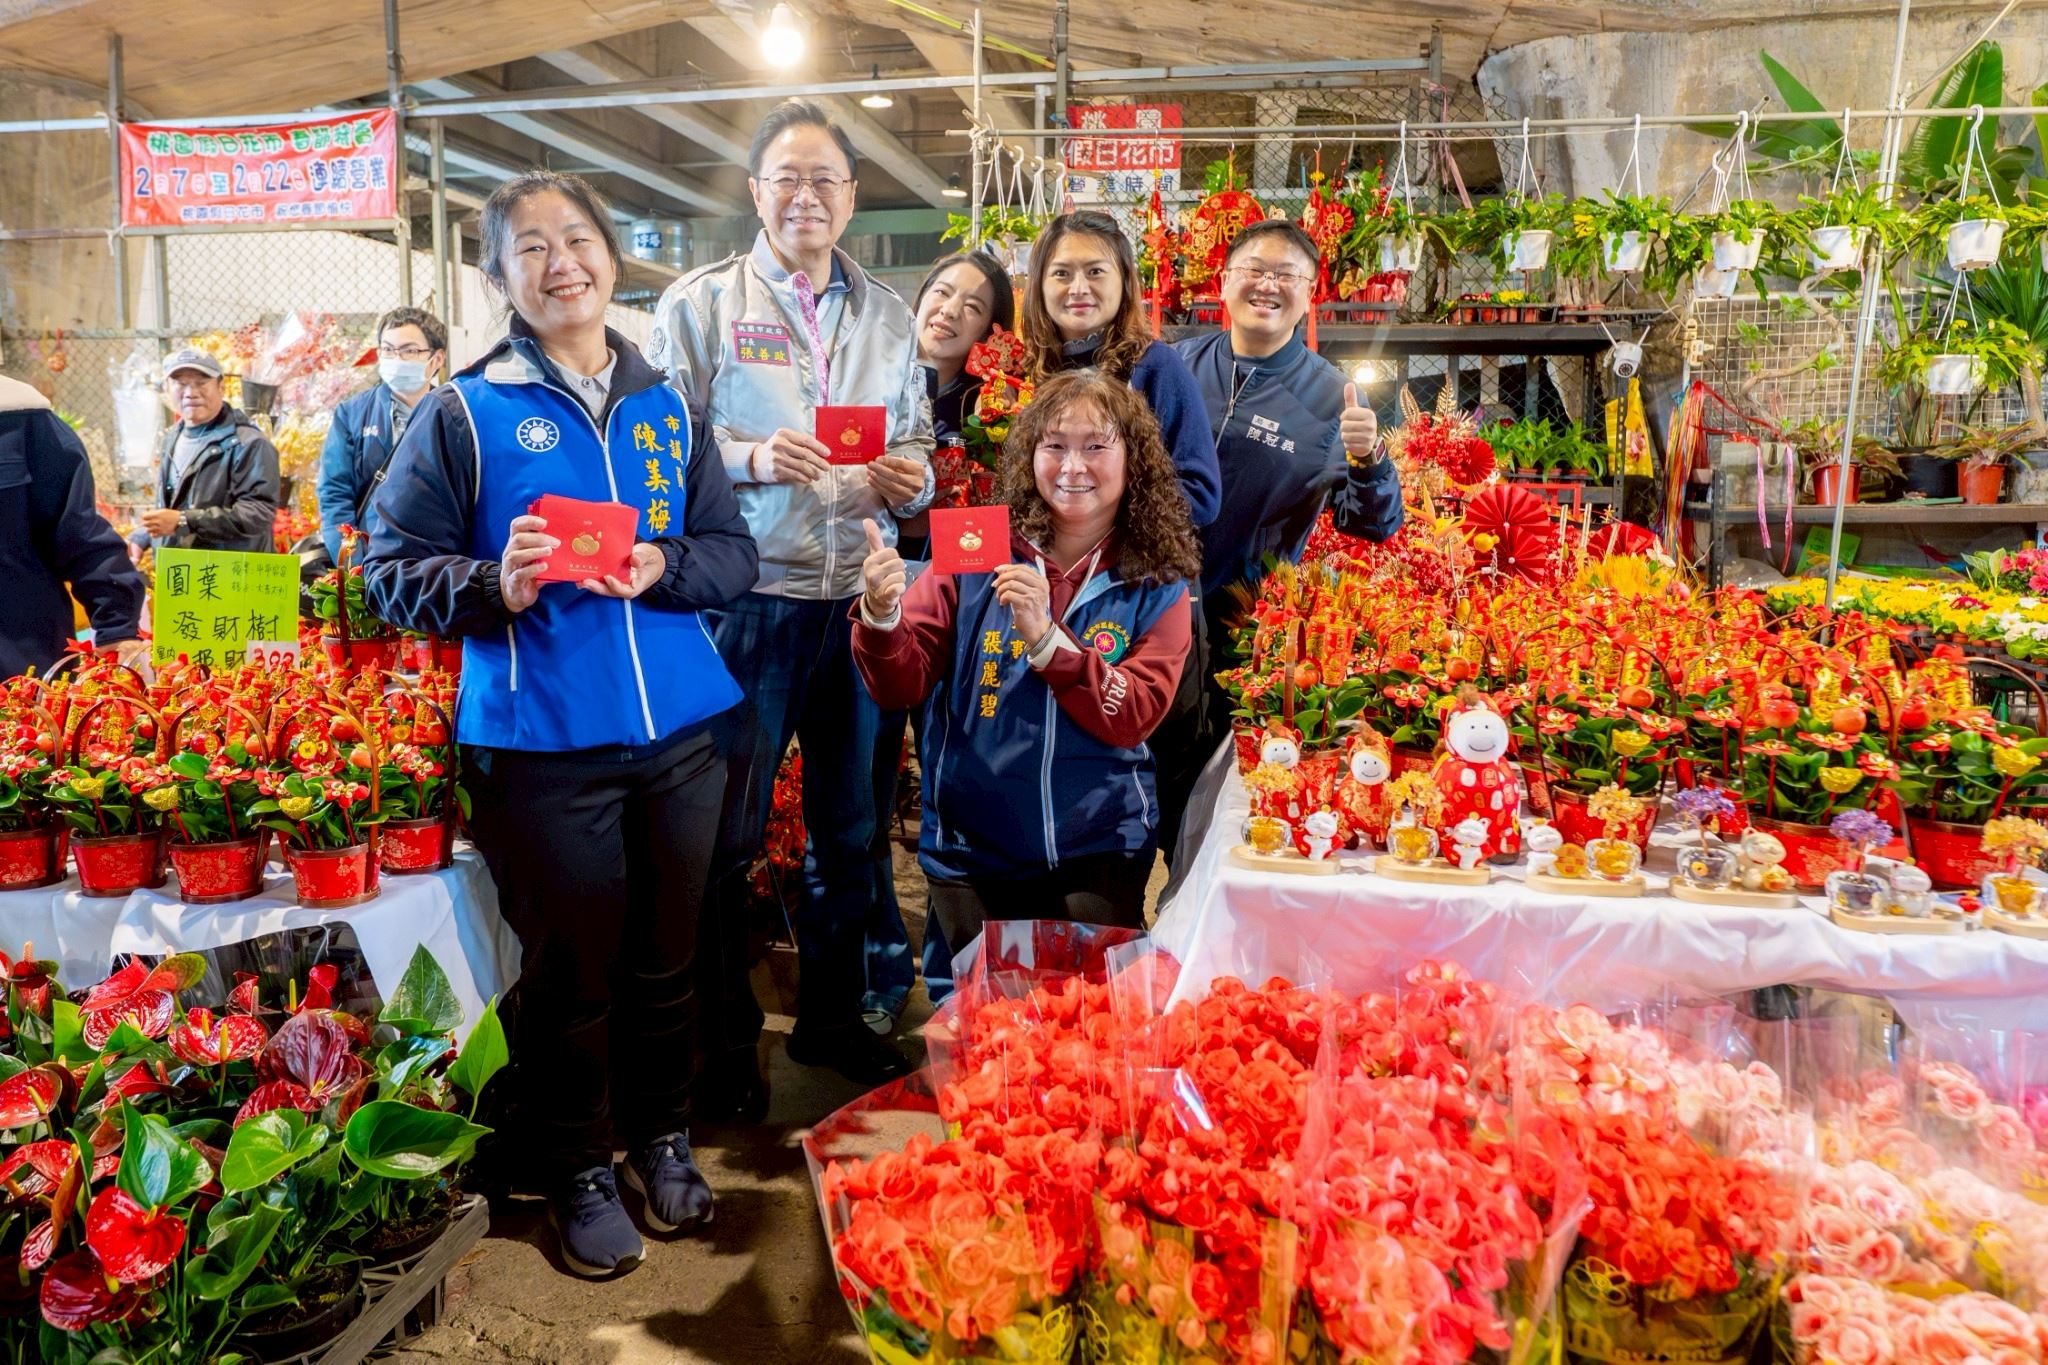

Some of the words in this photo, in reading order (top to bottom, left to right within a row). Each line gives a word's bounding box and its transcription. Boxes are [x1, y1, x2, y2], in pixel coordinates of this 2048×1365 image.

[1067, 137, 1175, 167] 假日花市
[309, 157, 386, 191] 連續營業
[737, 324, 784, 336] 桃園市政府
[738, 337, 756, 347] 市長
[740, 346, 788, 362] 張善政
[663, 414, 684, 493] 市議員
[632, 421, 671, 535] 陳美梅
[166, 563, 223, 601] 圓葉
[172, 608, 279, 641] 發財樹
[979, 629, 1003, 718] 張麗碧
